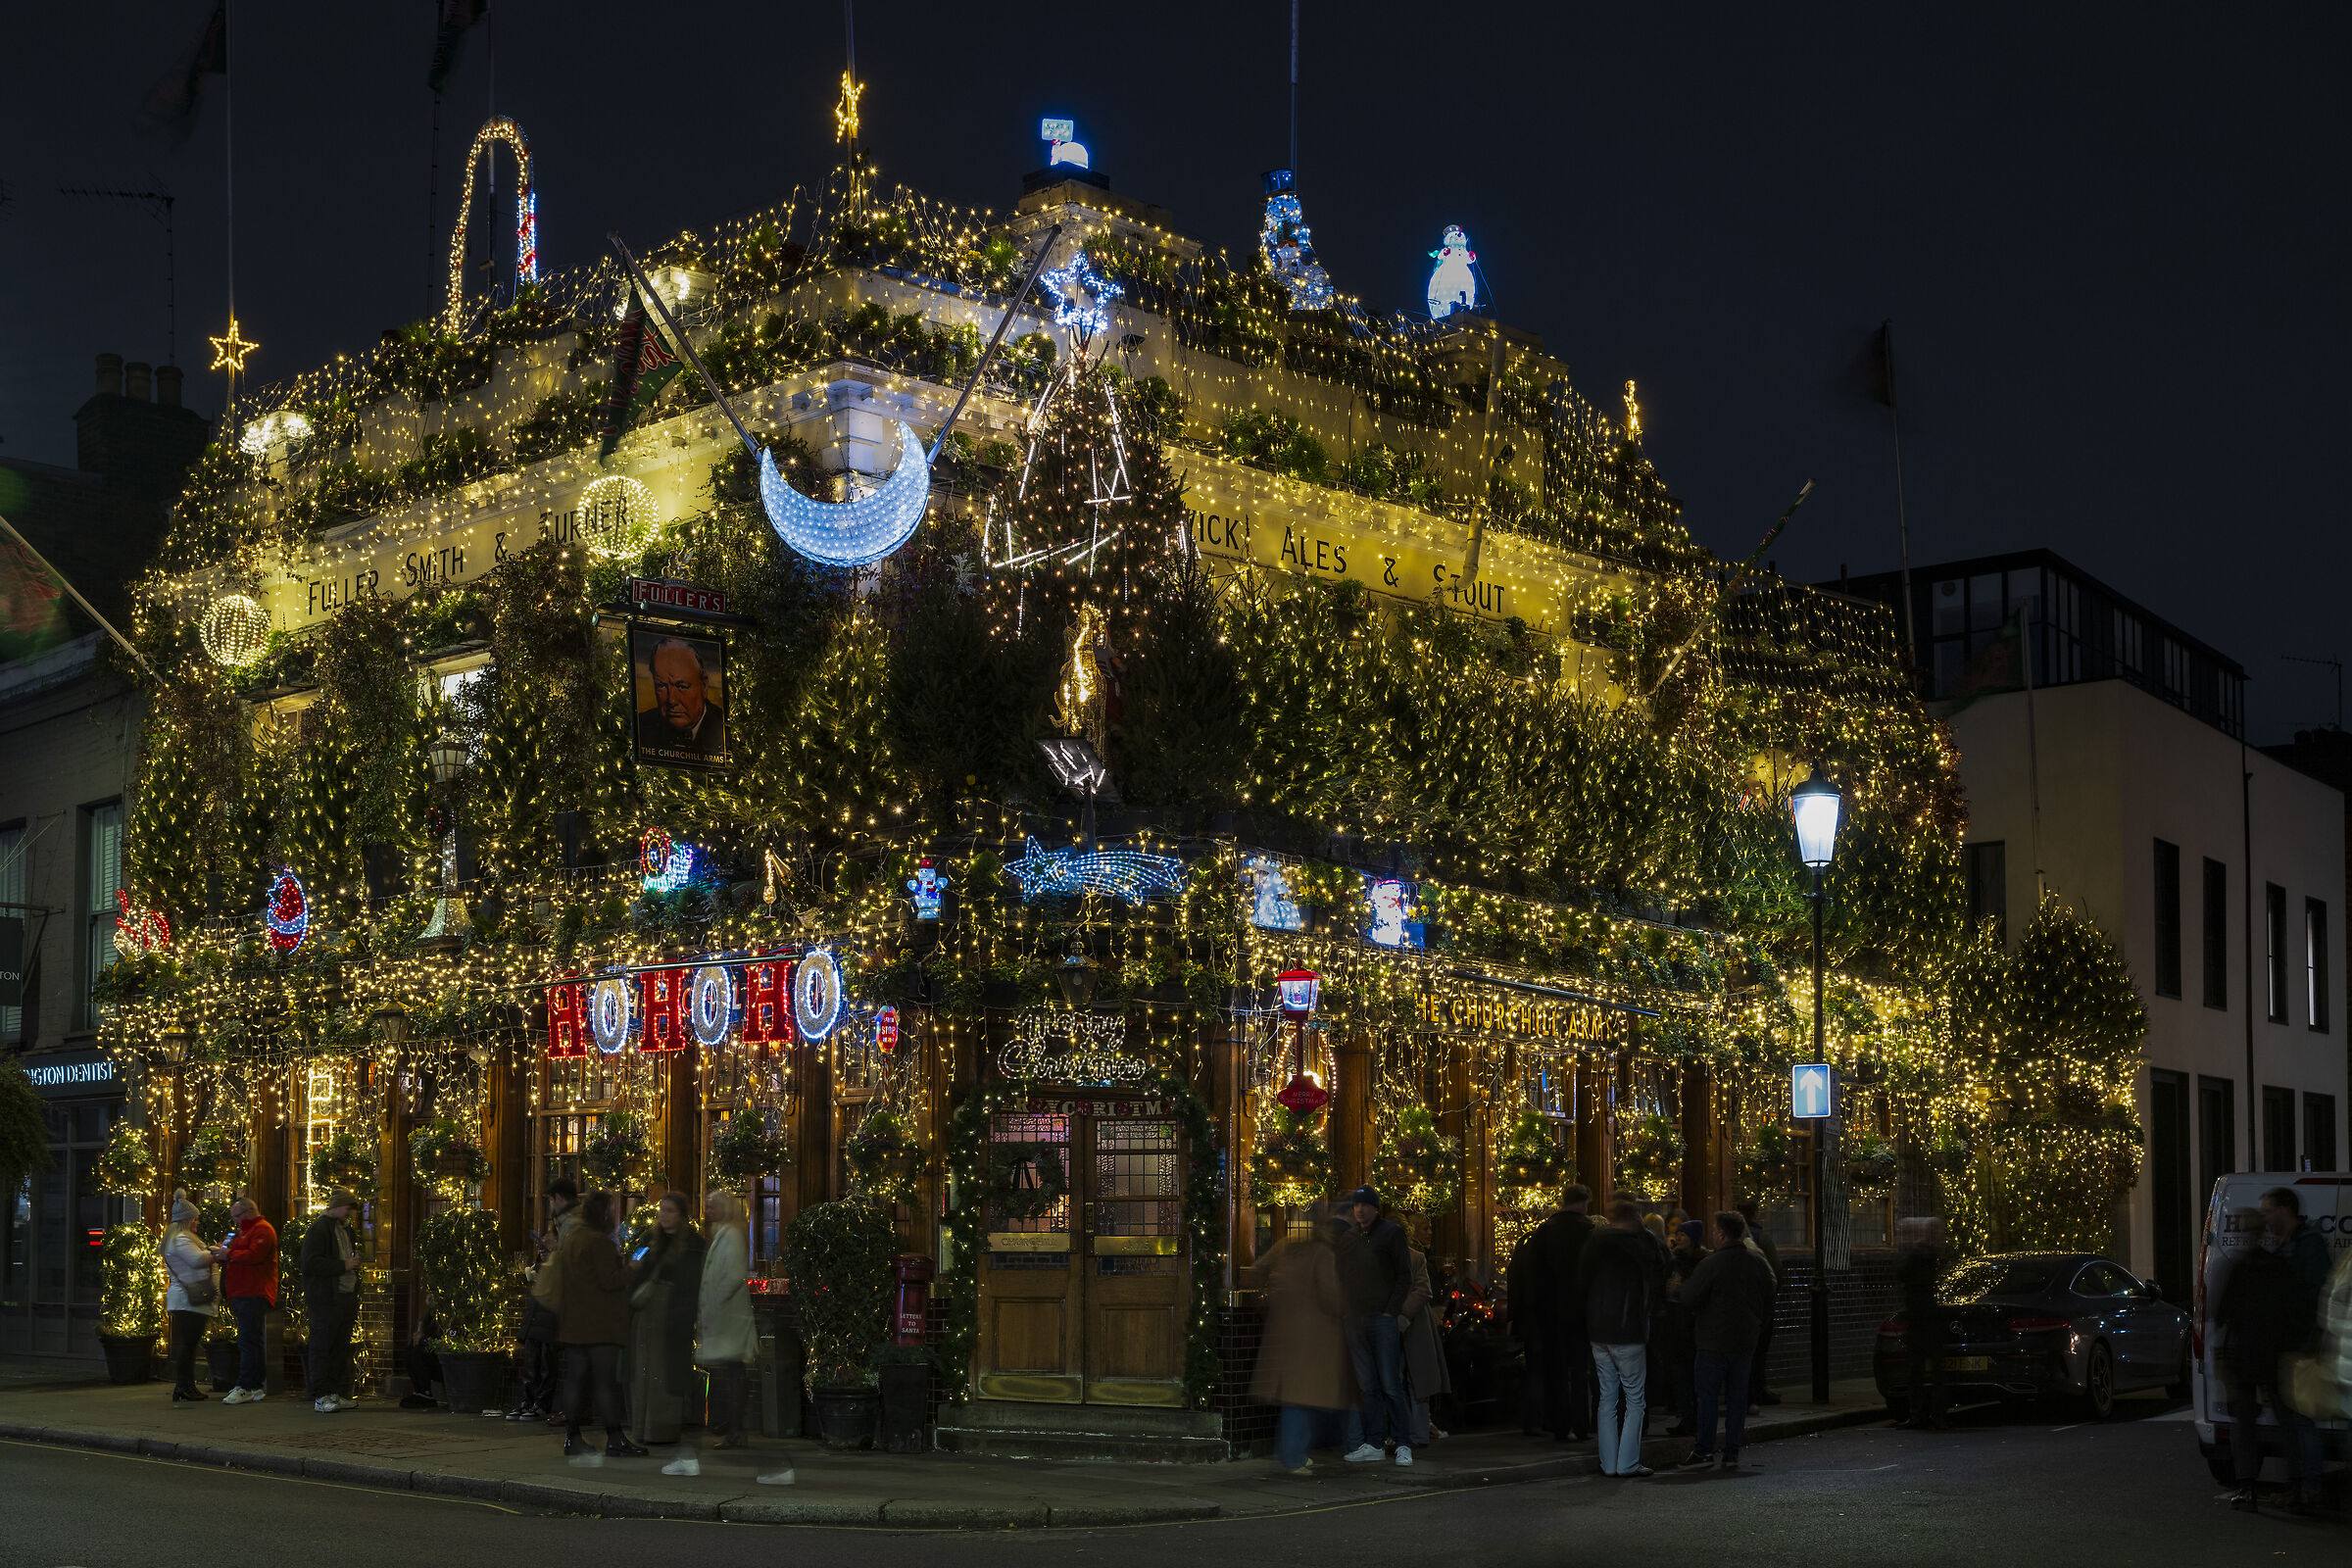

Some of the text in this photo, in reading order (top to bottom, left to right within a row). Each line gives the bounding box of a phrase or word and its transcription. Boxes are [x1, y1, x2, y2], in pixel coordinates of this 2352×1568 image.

[496, 532, 508, 564] &
[1281, 525, 1348, 574] ALES
[1384, 557, 1398, 588] &
[638, 581, 720, 612] FULLER'S
[642, 747, 724, 763] THE CHURCHILL ARMS
[881, 1025, 896, 1035] STOP
[1451, 998, 1559, 1037] CHURCHILL
[1568, 1012, 1613, 1042] ARMS
[67, 1061, 115, 1083] DENTIST
